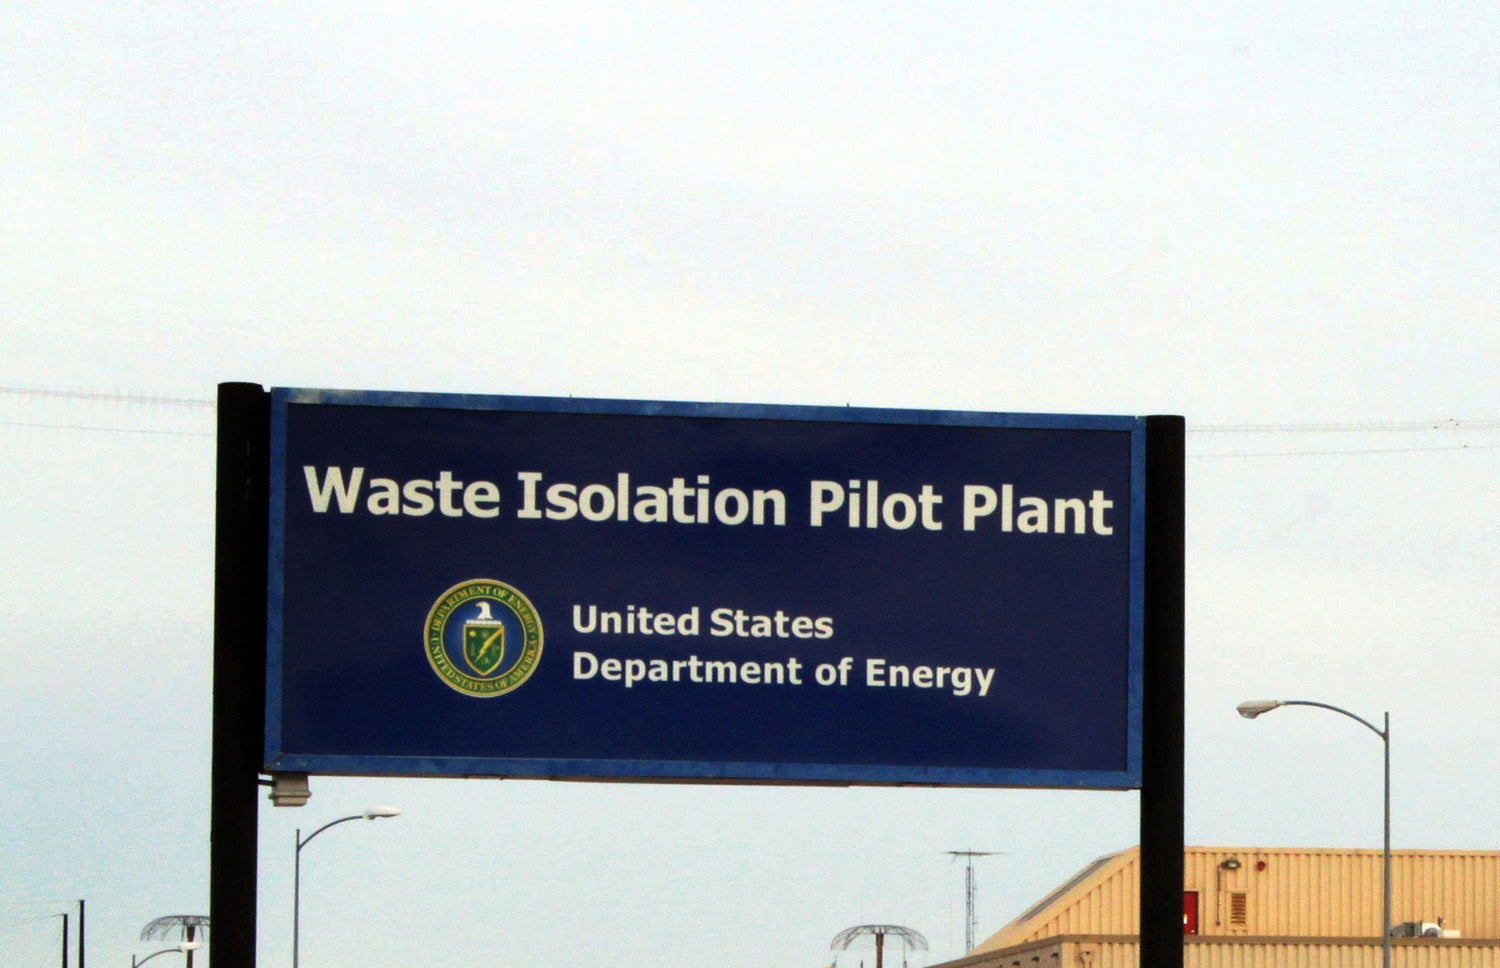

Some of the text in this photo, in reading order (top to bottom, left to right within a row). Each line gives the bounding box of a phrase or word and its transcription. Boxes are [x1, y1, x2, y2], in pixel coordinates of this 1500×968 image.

[303, 466, 1114, 536] Waste Isolation Pilot Plant
[572, 604, 834, 640] United States
[573, 651, 996, 697] Department of Energy
